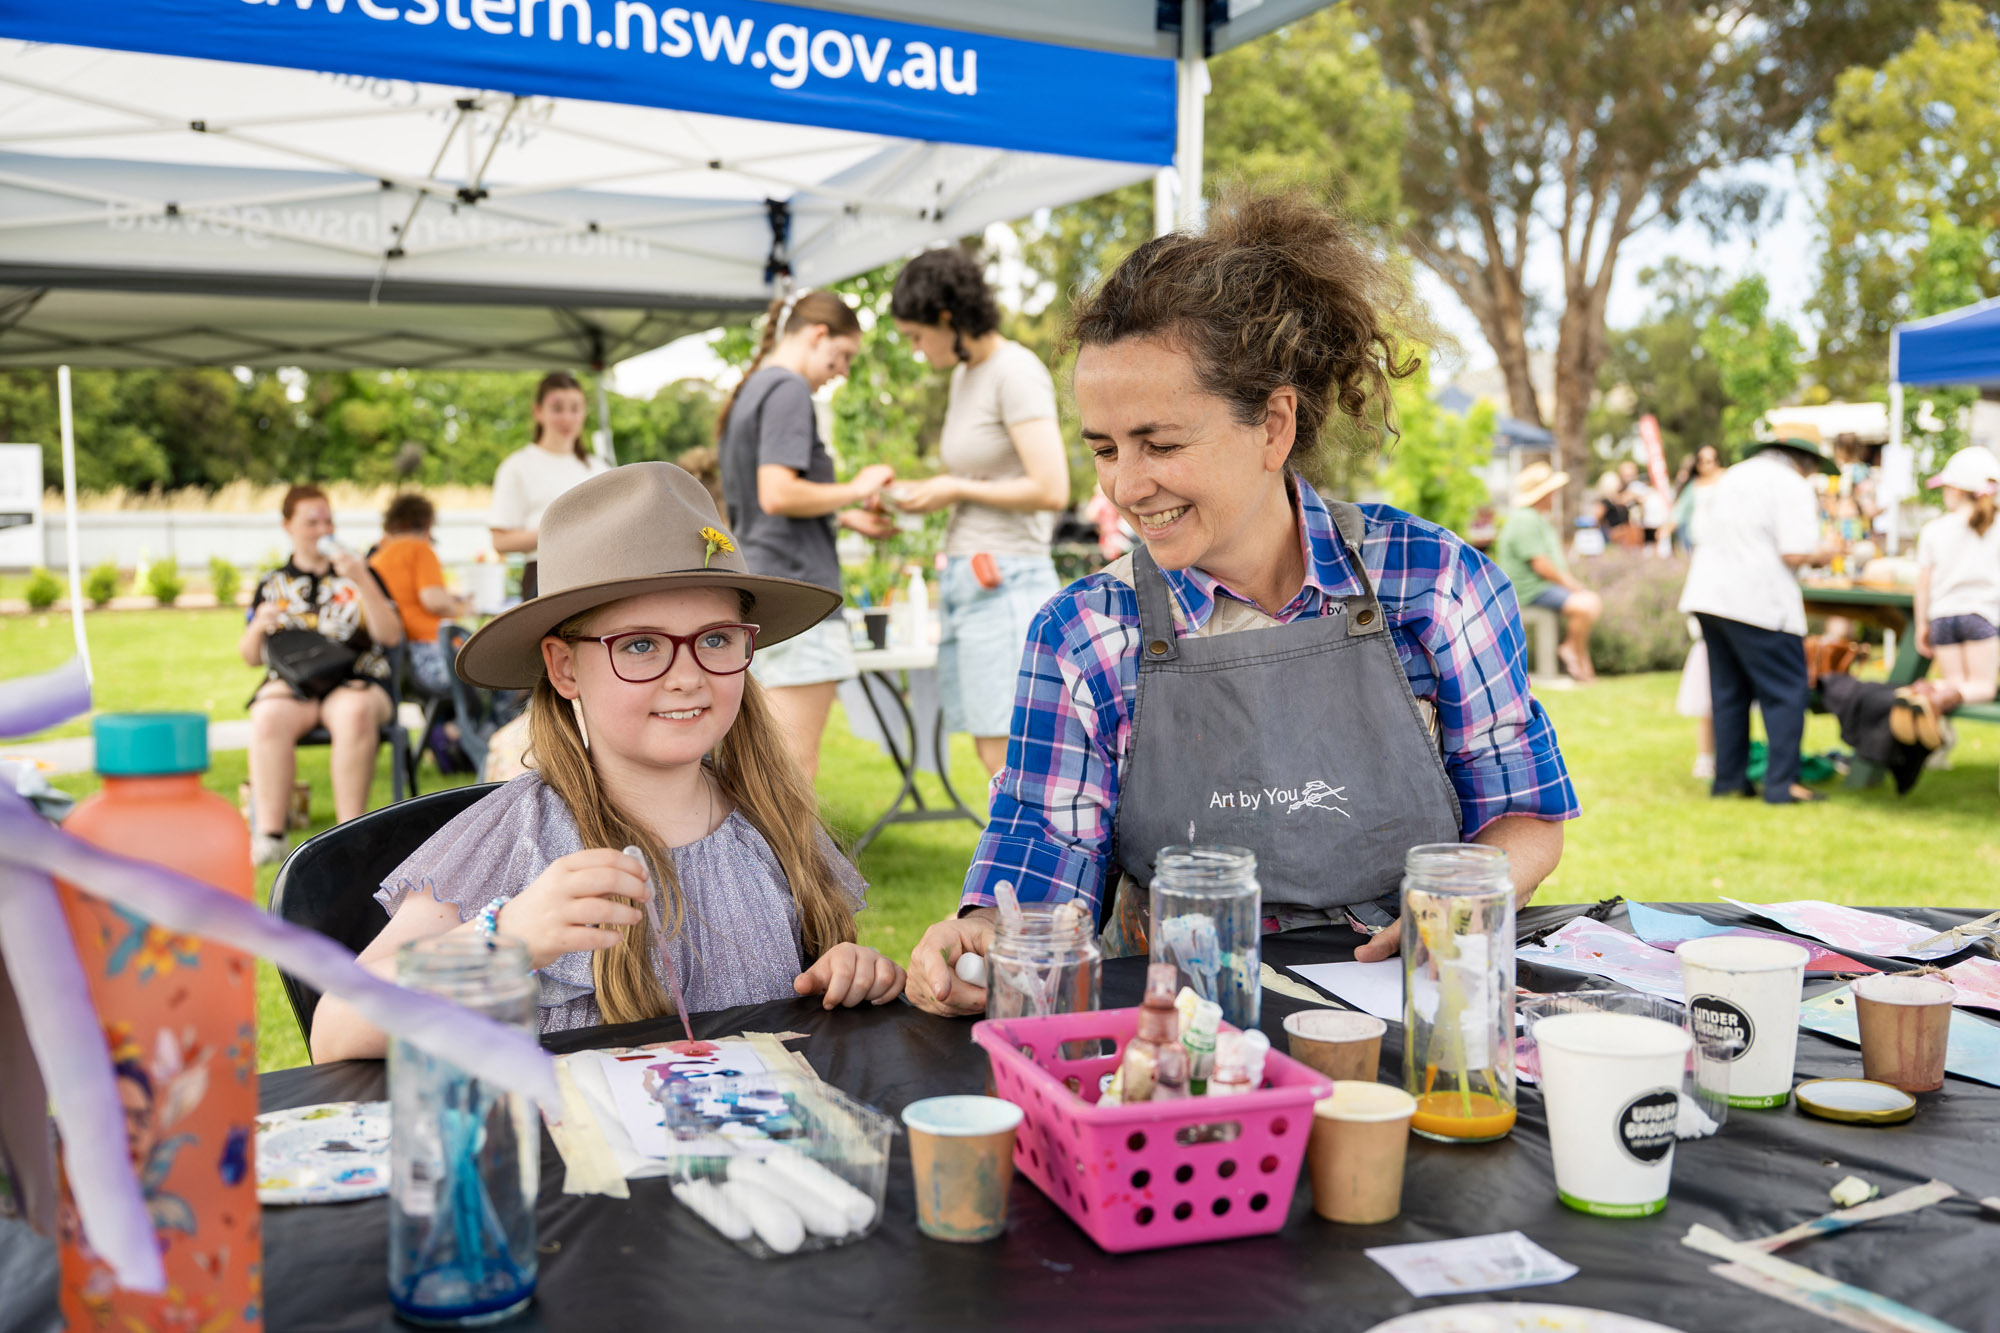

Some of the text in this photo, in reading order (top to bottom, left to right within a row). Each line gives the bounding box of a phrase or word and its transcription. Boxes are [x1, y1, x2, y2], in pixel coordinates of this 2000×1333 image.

[1209, 787, 1298, 811] Art by You
